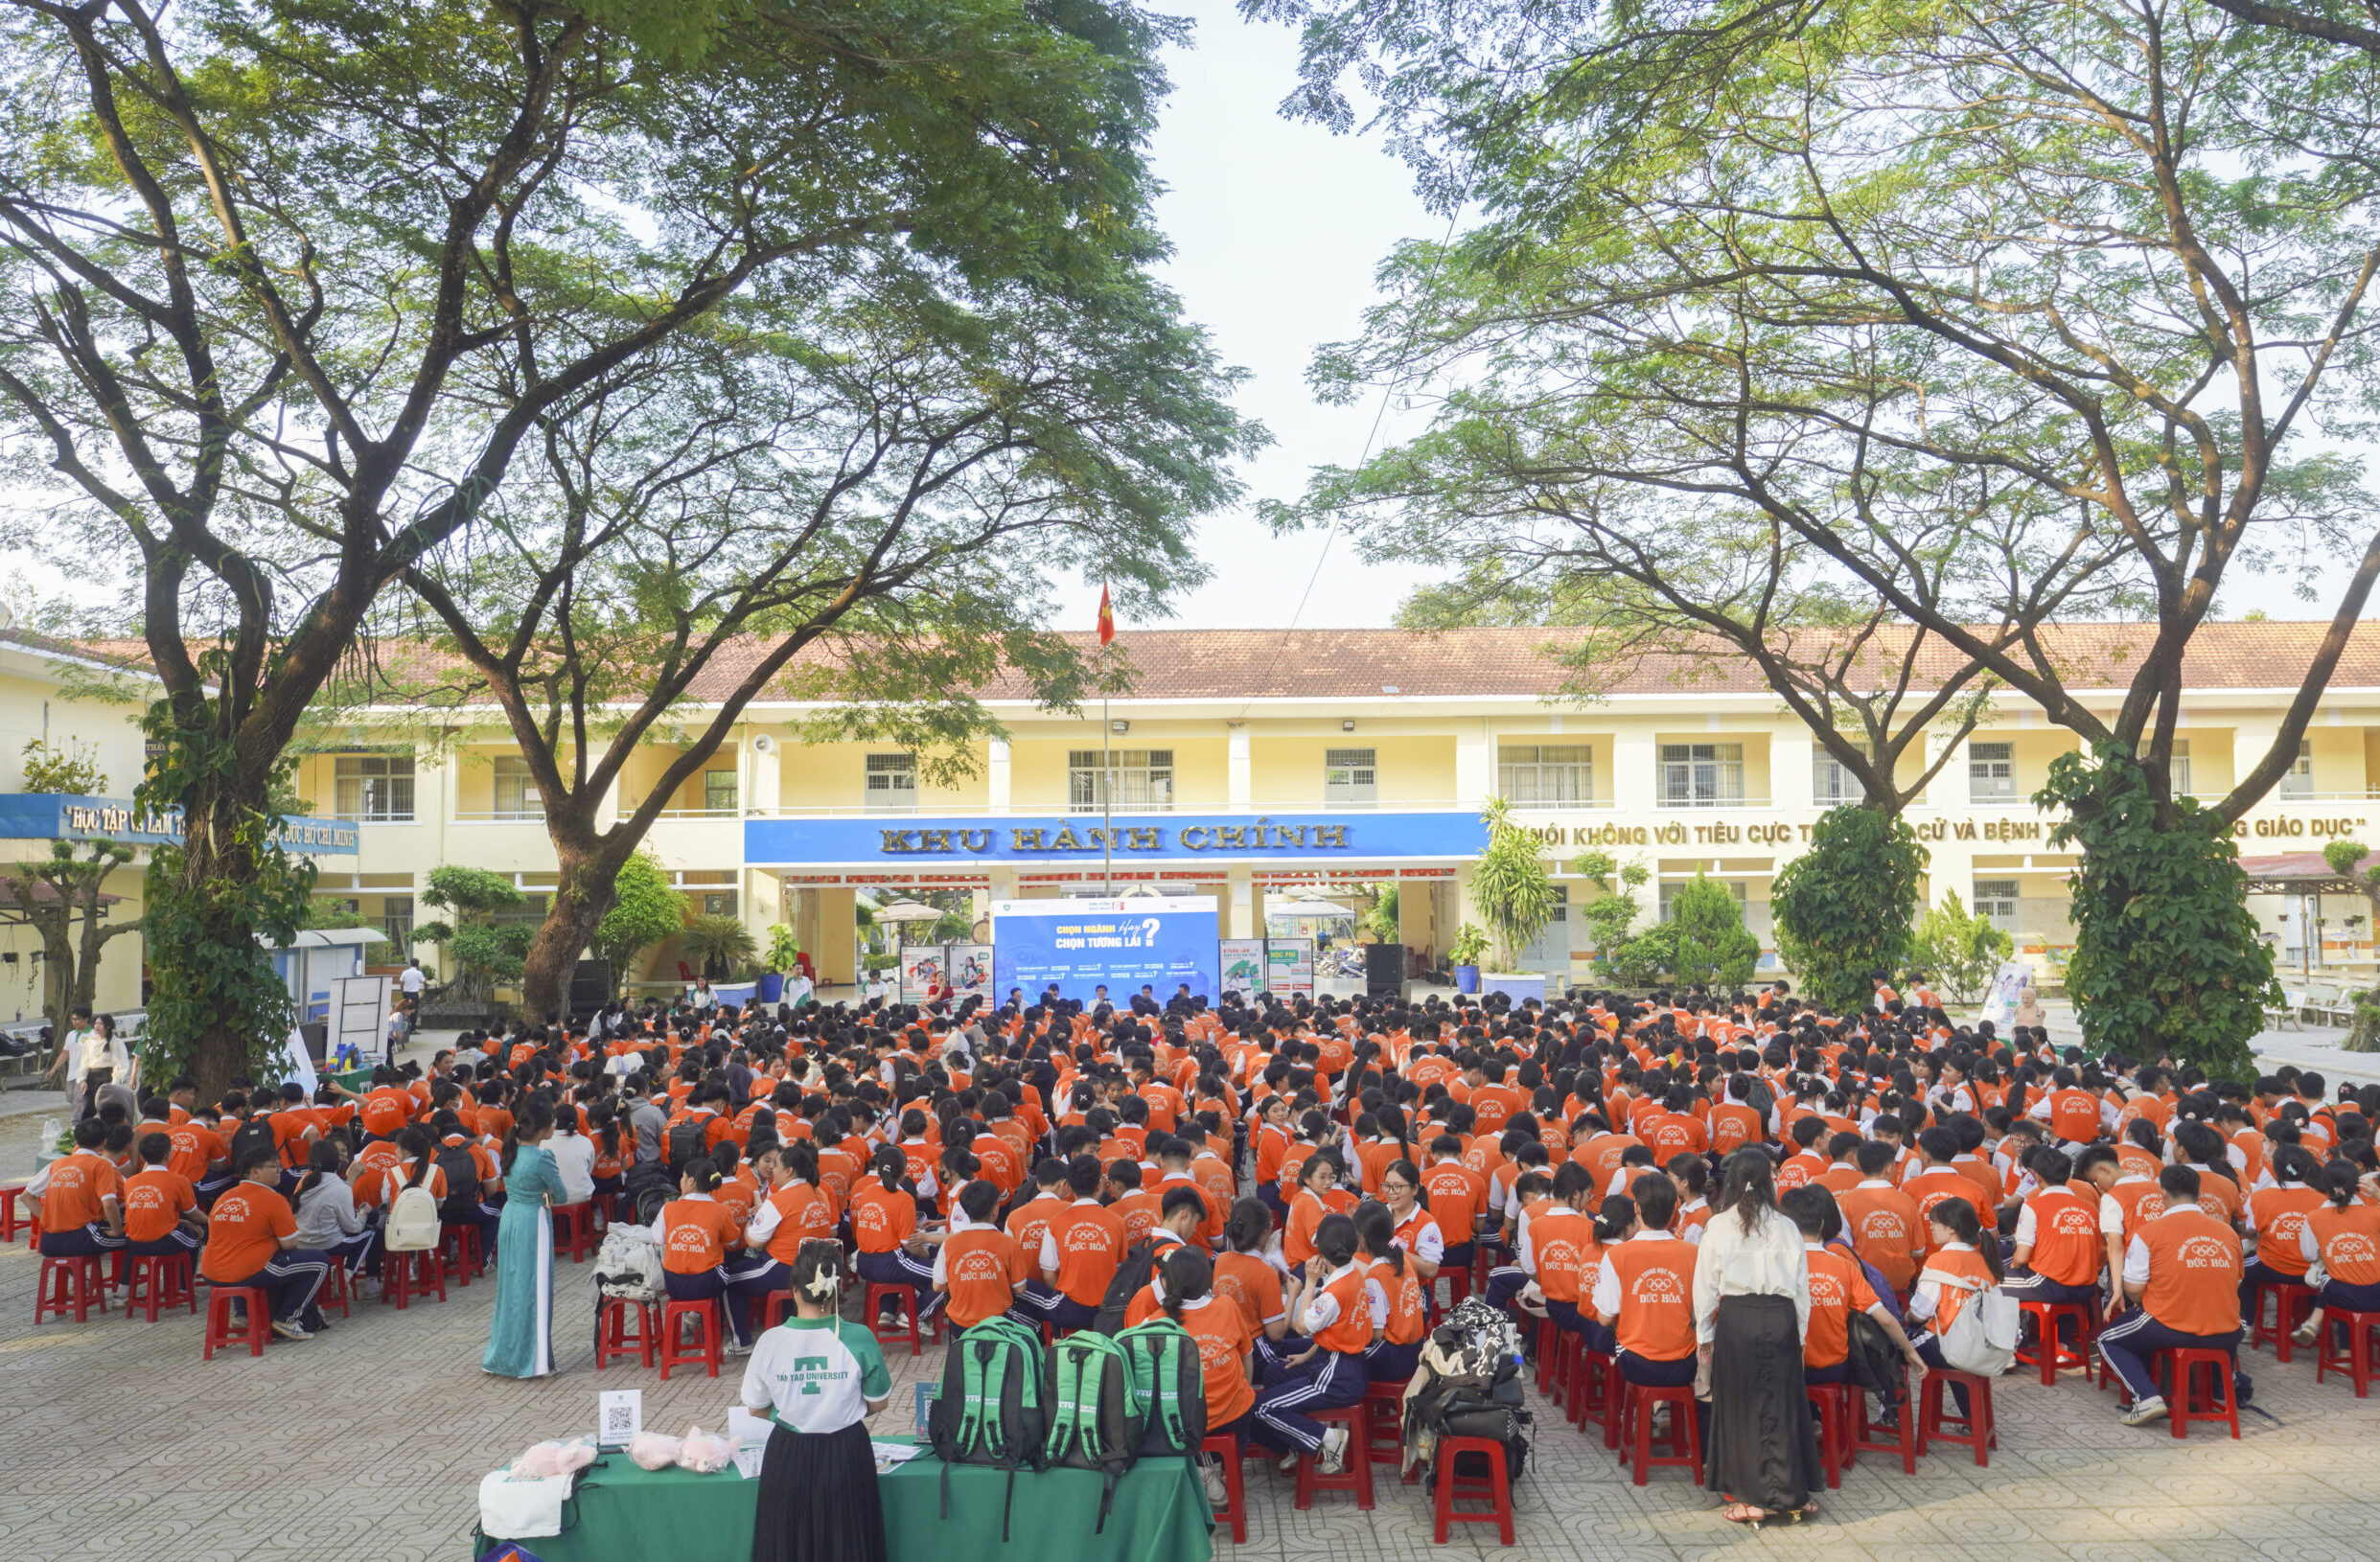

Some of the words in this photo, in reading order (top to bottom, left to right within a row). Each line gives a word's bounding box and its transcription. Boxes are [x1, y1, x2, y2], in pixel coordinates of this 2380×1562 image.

[103, 804, 127, 835] TẬP
[285, 822, 303, 844] ĐỨC
[304, 821, 316, 844] HỒ
[879, 828, 991, 854] KHU
[1010, 818, 1162, 852] HÀNH
[1179, 816, 1348, 851] CHÍNH
[1573, 821, 1647, 845] KHÔNG
[1653, 820, 1687, 844] VỚI
[1694, 820, 1740, 844] TIÊU
[1747, 820, 1791, 846] CỰC
[1953, 817, 1976, 840] VÀ
[1984, 817, 2040, 843] BỆNH
[2255, 815, 2302, 837] GIÁO
[1056, 926, 1081, 935] CHỌN
[1083, 924, 1115, 933] NGÀNH
[1118, 919, 1142, 937] Hay
[1055, 937, 1085, 950] CHỌN
[1087, 936, 1122, 948] TƯƠNG
[1124, 936, 1141, 947] LAI
[1270, 951, 1282, 959] HỌC
[1790, 1180, 1802, 1188] HÒA
[1433, 1187, 1447, 1196] ĐỨC
[1450, 1187, 1466, 1196] HÒA
[129, 1201, 141, 1209] ĐỨC
[144, 1201, 158, 1209] HÒA
[229, 1214, 244, 1223] HÒA
[1867, 1229, 1885, 1238] ĐỨC
[1887, 1229, 1904, 1238] HÒA
[2060, 1226, 2076, 1234] ĐỨC
[2078, 1226, 2094, 1235] HÒA
[2276, 1230, 2295, 1240] ĐỨC
[671, 1242, 686, 1252] ĐỨC
[689, 1243, 705, 1253] HÒA
[1022, 1240, 1039, 1250] ĐỨC
[1069, 1242, 1087, 1252] ĐỨC
[1089, 1242, 1107, 1252] HÒA
[2186, 1257, 2207, 1268] ĐỨC
[2210, 1257, 2230, 1269] HÒA
[2334, 1253, 2353, 1264] ĐỨC
[2354, 1252, 2374, 1262] HÒA
[1545, 1261, 1560, 1271] ĐỨC
[1563, 1262, 1581, 1272] HÒA
[960, 1271, 978, 1281] ĐỨC
[980, 1271, 997, 1280] HÒA
[1640, 1293, 1658, 1303] ĐỨC
[1661, 1293, 1681, 1303] HÒA
[1822, 1296, 1842, 1307] HÒA
[1213, 1353, 1231, 1367] HÒA
[790, 1373, 804, 1382] TAO
[806, 1371, 848, 1381] UNIVERSITY
[965, 1394, 981, 1403] TTU
[1057, 1401, 1075, 1410] TTU
